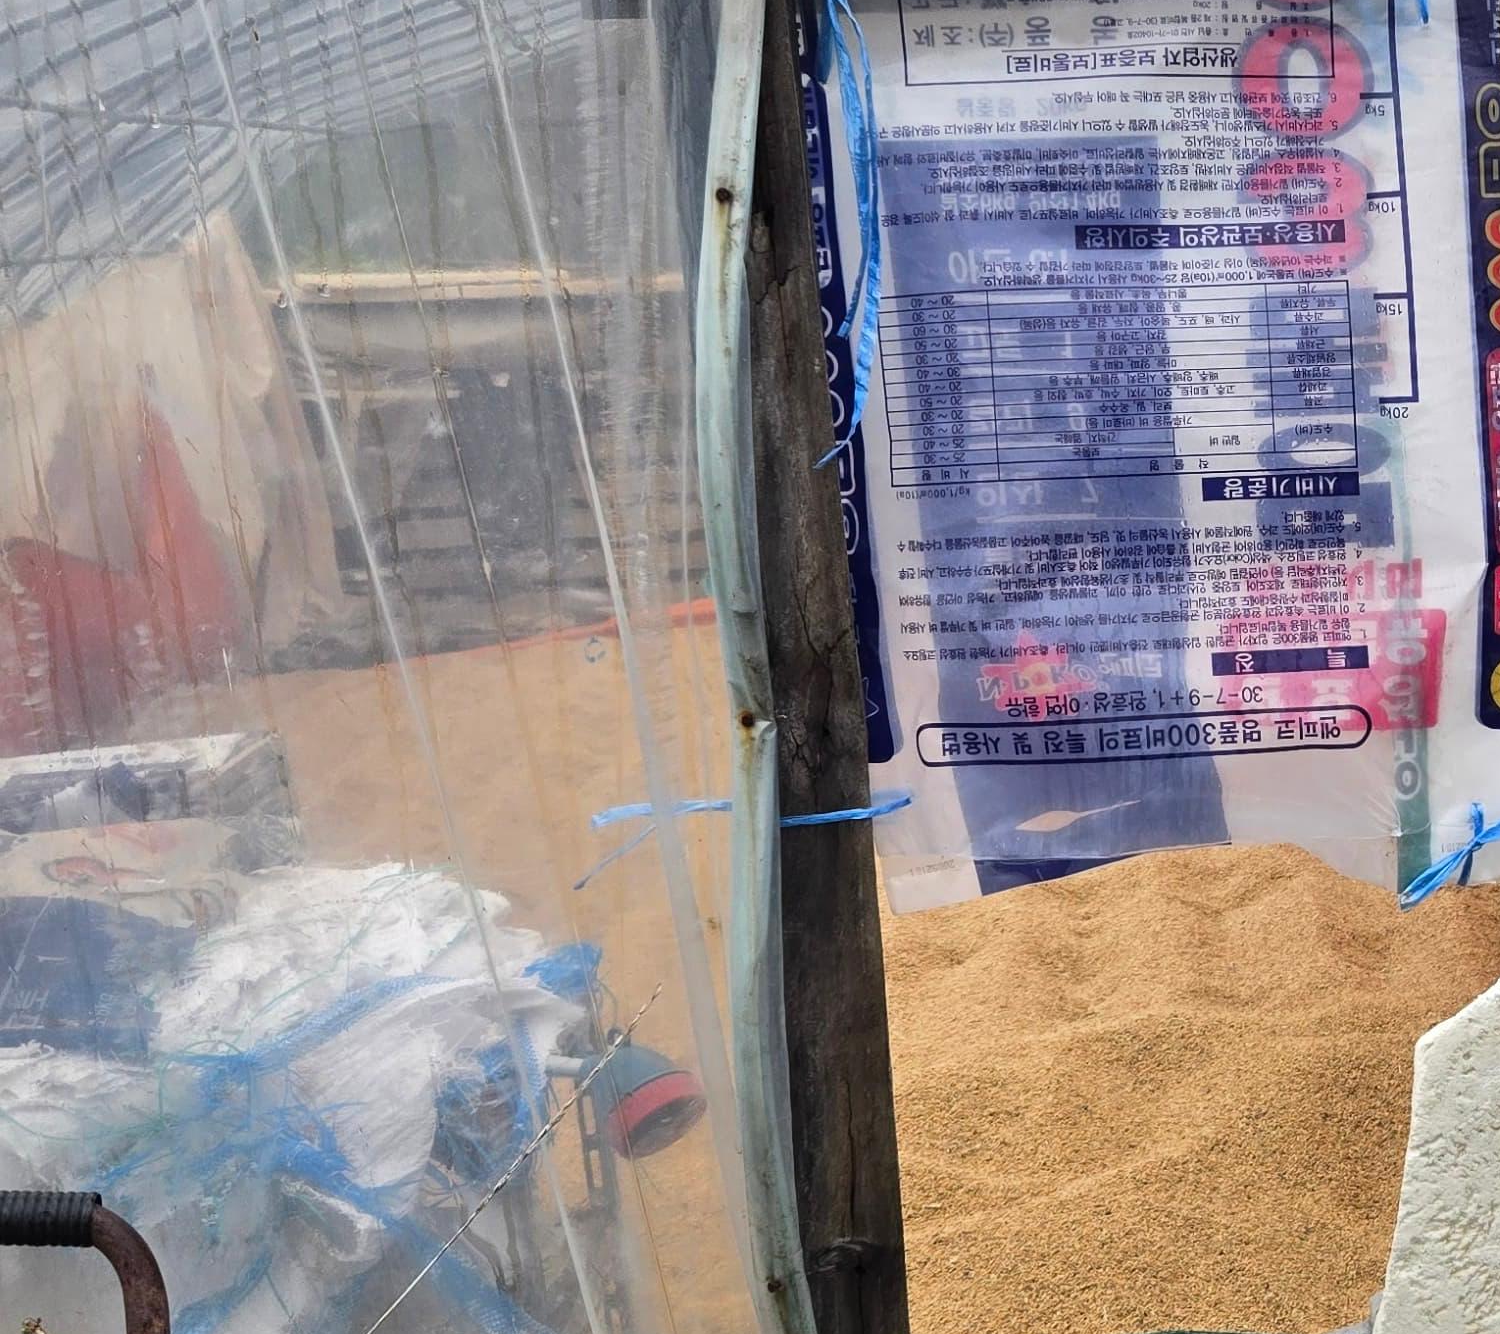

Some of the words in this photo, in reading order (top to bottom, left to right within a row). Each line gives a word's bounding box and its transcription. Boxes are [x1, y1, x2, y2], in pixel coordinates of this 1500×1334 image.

[1005, 49, 1156, 74] 보증표[보통비료]
[1163, 47, 1237, 68] 생산업자
[1364, 103, 1385, 116] 5kg
[1368, 200, 1396, 214] 10kg
[1083, 224, 1171, 248] 주의사항
[1179, 222, 1336, 246] 사용상·보관상의
[1375, 303, 1403, 315] 15kg
[1379, 406, 1409, 419] 20kg
[922, 425, 935, 436] 30
[951, 424, 964, 434] 20
[923, 440, 935, 450] 40
[952, 438, 965, 448] 25
[924, 453, 936, 464] 30
[953, 452, 965, 462] 25
[1222, 475, 1339, 498] 시비기준량
[1235, 653, 1255, 673] 징
[1327, 649, 1347, 668] 특
[1005, 697, 1041, 718] 함유
[1098, 720, 1262, 752] 명품300비료의
[1274, 716, 1341, 739] 엔피코
[941, 731, 1001, 756] 사용법
[1013, 732, 1032, 755] 및
[1044, 730, 1087, 753] 특징
